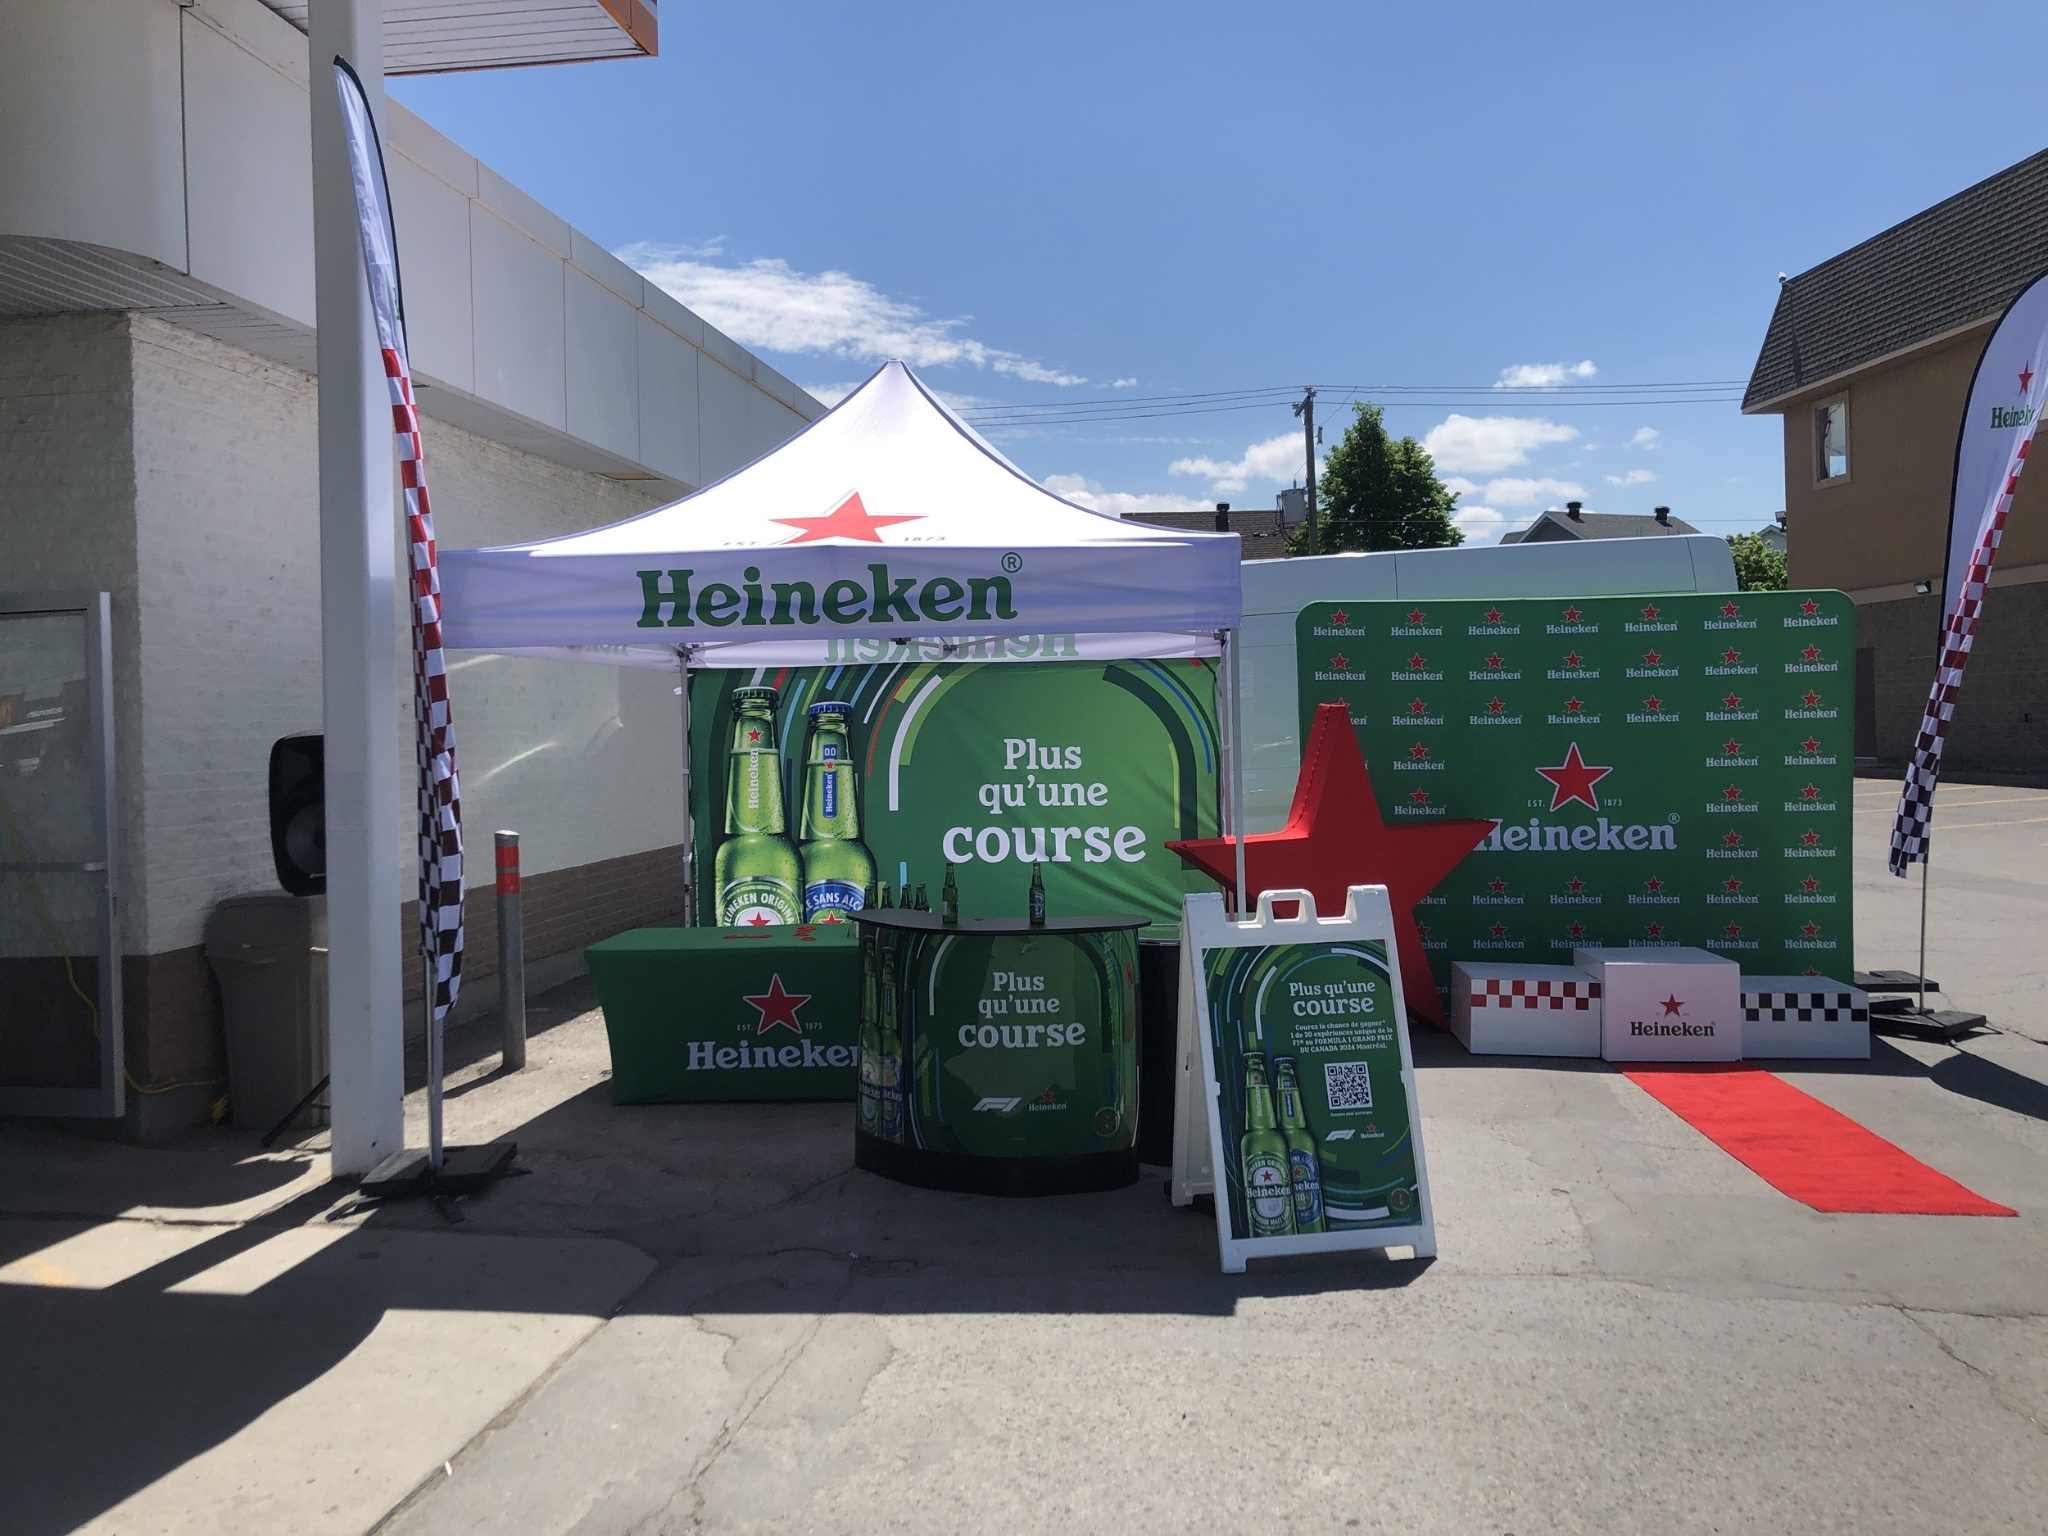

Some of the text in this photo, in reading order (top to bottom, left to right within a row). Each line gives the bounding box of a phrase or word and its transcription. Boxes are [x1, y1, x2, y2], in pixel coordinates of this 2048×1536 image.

[1990, 404, 2036, 429] Heinek
[1624, 621, 1678, 632] Heineken
[1703, 619, 1757, 630] Heineken
[1783, 617, 1838, 628] Heineken
[1313, 626, 1366, 637] Heineken
[1390, 625, 1443, 636] Heineken
[1468, 625, 1521, 636] Heineken
[1545, 623, 1599, 634] Heineken
[1625, 667, 1679, 678] Heineken
[1704, 665, 1758, 676] Heineken
[1784, 662, 1838, 673] Heineken
[1314, 670, 1366, 681] Heineken
[1390, 670, 1443, 681] Heineken
[1468, 670, 1521, 681] Heineken
[1547, 668, 1600, 679] Heineken
[1547, 713, 1601, 724] Heineken
[1626, 712, 1680, 723] Heineken
[1705, 710, 1759, 721] Heineken
[1784, 708, 1838, 719] Heineken
[1392, 715, 1444, 726] Heineken
[1469, 714, 1522, 725] Heineken
[1003, 738, 1082, 770] Plus
[1393, 760, 1445, 771] Heineken
[1705, 756, 1759, 767] Heineken
[1784, 755, 1837, 766] Heineken
[748, 749, 760, 810] Heineken
[826, 774, 834, 813] Heineken
[978, 775, 1109, 815] qu'une
[1527, 798, 1623, 808] EST. 1873
[1705, 802, 1759, 813] Heineken
[1784, 801, 1837, 812] Heineken
[1393, 804, 1446, 815] Heineken
[942, 825, 1147, 864] course
[1706, 848, 1759, 859] Heineken
[1783, 847, 1836, 858] Heineken
[814, 892, 840, 907] SANS
[1472, 894, 1525, 905] Heineken
[1549, 893, 1603, 904] Heineken
[1627, 893, 1681, 904] Heineken
[1706, 893, 1759, 904] Heineken
[1784, 893, 1837, 904] Heineken
[760, 892, 796, 925] ORIGINA
[1472, 937, 1525, 948] Heineken
[1706, 938, 1759, 949] Heineken
[1784, 938, 1837, 949] Heineken
[992, 971, 1045, 992] Plus
[1289, 980, 1376, 998] Plus qu'une
[978, 994, 1060, 1019] qu'une
[1293, 997, 1375, 1017] course
[736, 1022, 823, 1032] EST. 1873
[1295, 1023, 1319, 1031] Courez
[1326, 1021, 1350, 1029] chance
[1630, 1021, 1715, 1037] Heineken
[958, 1022, 1086, 1049] course
[1313, 1029, 1354, 1038] expériences
[1314, 1037, 1347, 1045] FORMULA
[1310, 1045, 1339, 1053] CANADA
[1028, 1102, 1067, 1112] Heineken
[1246, 1185, 1291, 1198] Heineken
